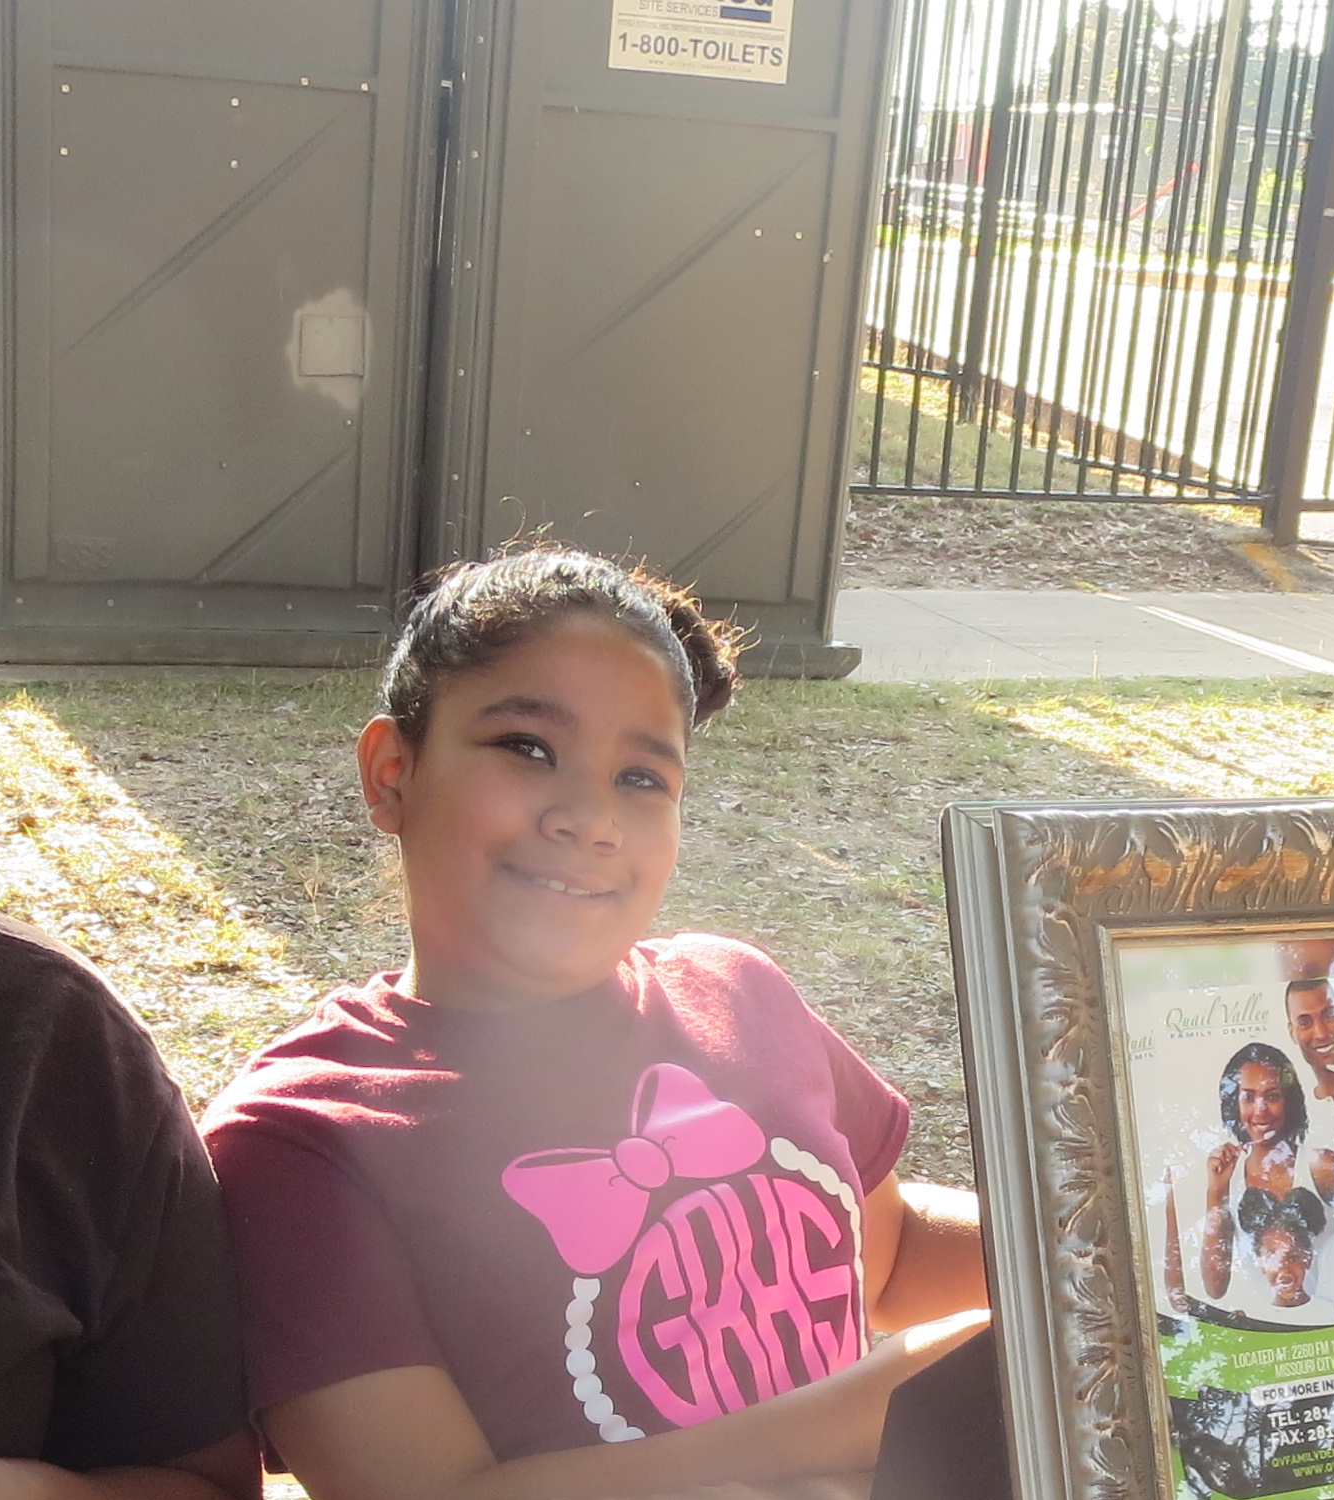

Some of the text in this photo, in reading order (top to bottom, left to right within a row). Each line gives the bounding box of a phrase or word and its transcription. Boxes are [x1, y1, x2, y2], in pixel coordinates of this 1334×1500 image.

[638, 0, 664, 13] SITE
[666, 2, 719, 18] SERVICES
[618, 32, 784, 67] 1-800-TOILETS
[1166, 995, 1220, 1033] Quail
[1169, 1025, 1268, 1039] FAMILY DENTAL
[1233, 1350, 1274, 1368] LOCATED
[1292, 1342, 1315, 1359] 2260
[1316, 1340, 1330, 1355] FM
[1275, 1360, 1317, 1378] MISSOURI
[1262, 1386, 1288, 1400] FOR
[1289, 1381, 1320, 1396] MORE
[1267, 1410, 1300, 1428] TEL:
[1270, 1428, 1305, 1447] FAX:
